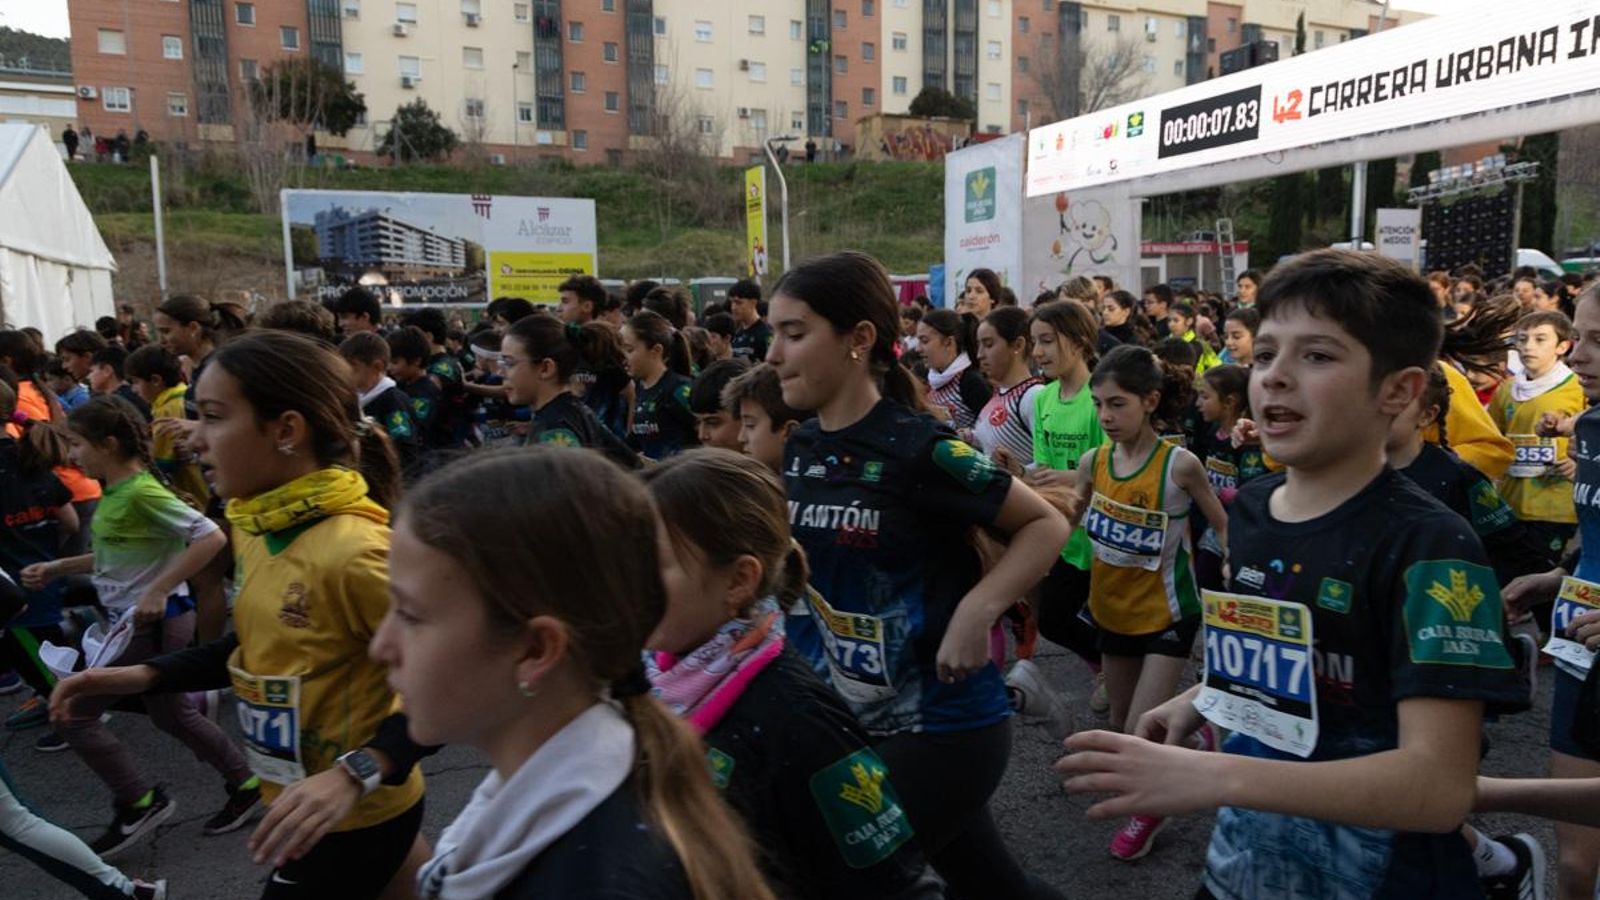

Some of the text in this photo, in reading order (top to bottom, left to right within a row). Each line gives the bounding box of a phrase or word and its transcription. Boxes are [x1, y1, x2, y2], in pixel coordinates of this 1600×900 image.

[1272, 89, 1302, 124] 42
[1308, 58, 1428, 117] CARRERA
[1435, 25, 1559, 89] URBANA
[1163, 100, 1259, 146] 00:00:07.83
[1379, 225, 1415, 235] ATENCIÓN
[385, 281, 468, 299] PROMOCIÓN
[1515, 447, 1554, 461] 353
[801, 500, 880, 532] ANTÓN
[1088, 512, 1162, 549] 11544
[1207, 630, 1308, 695] 10717
